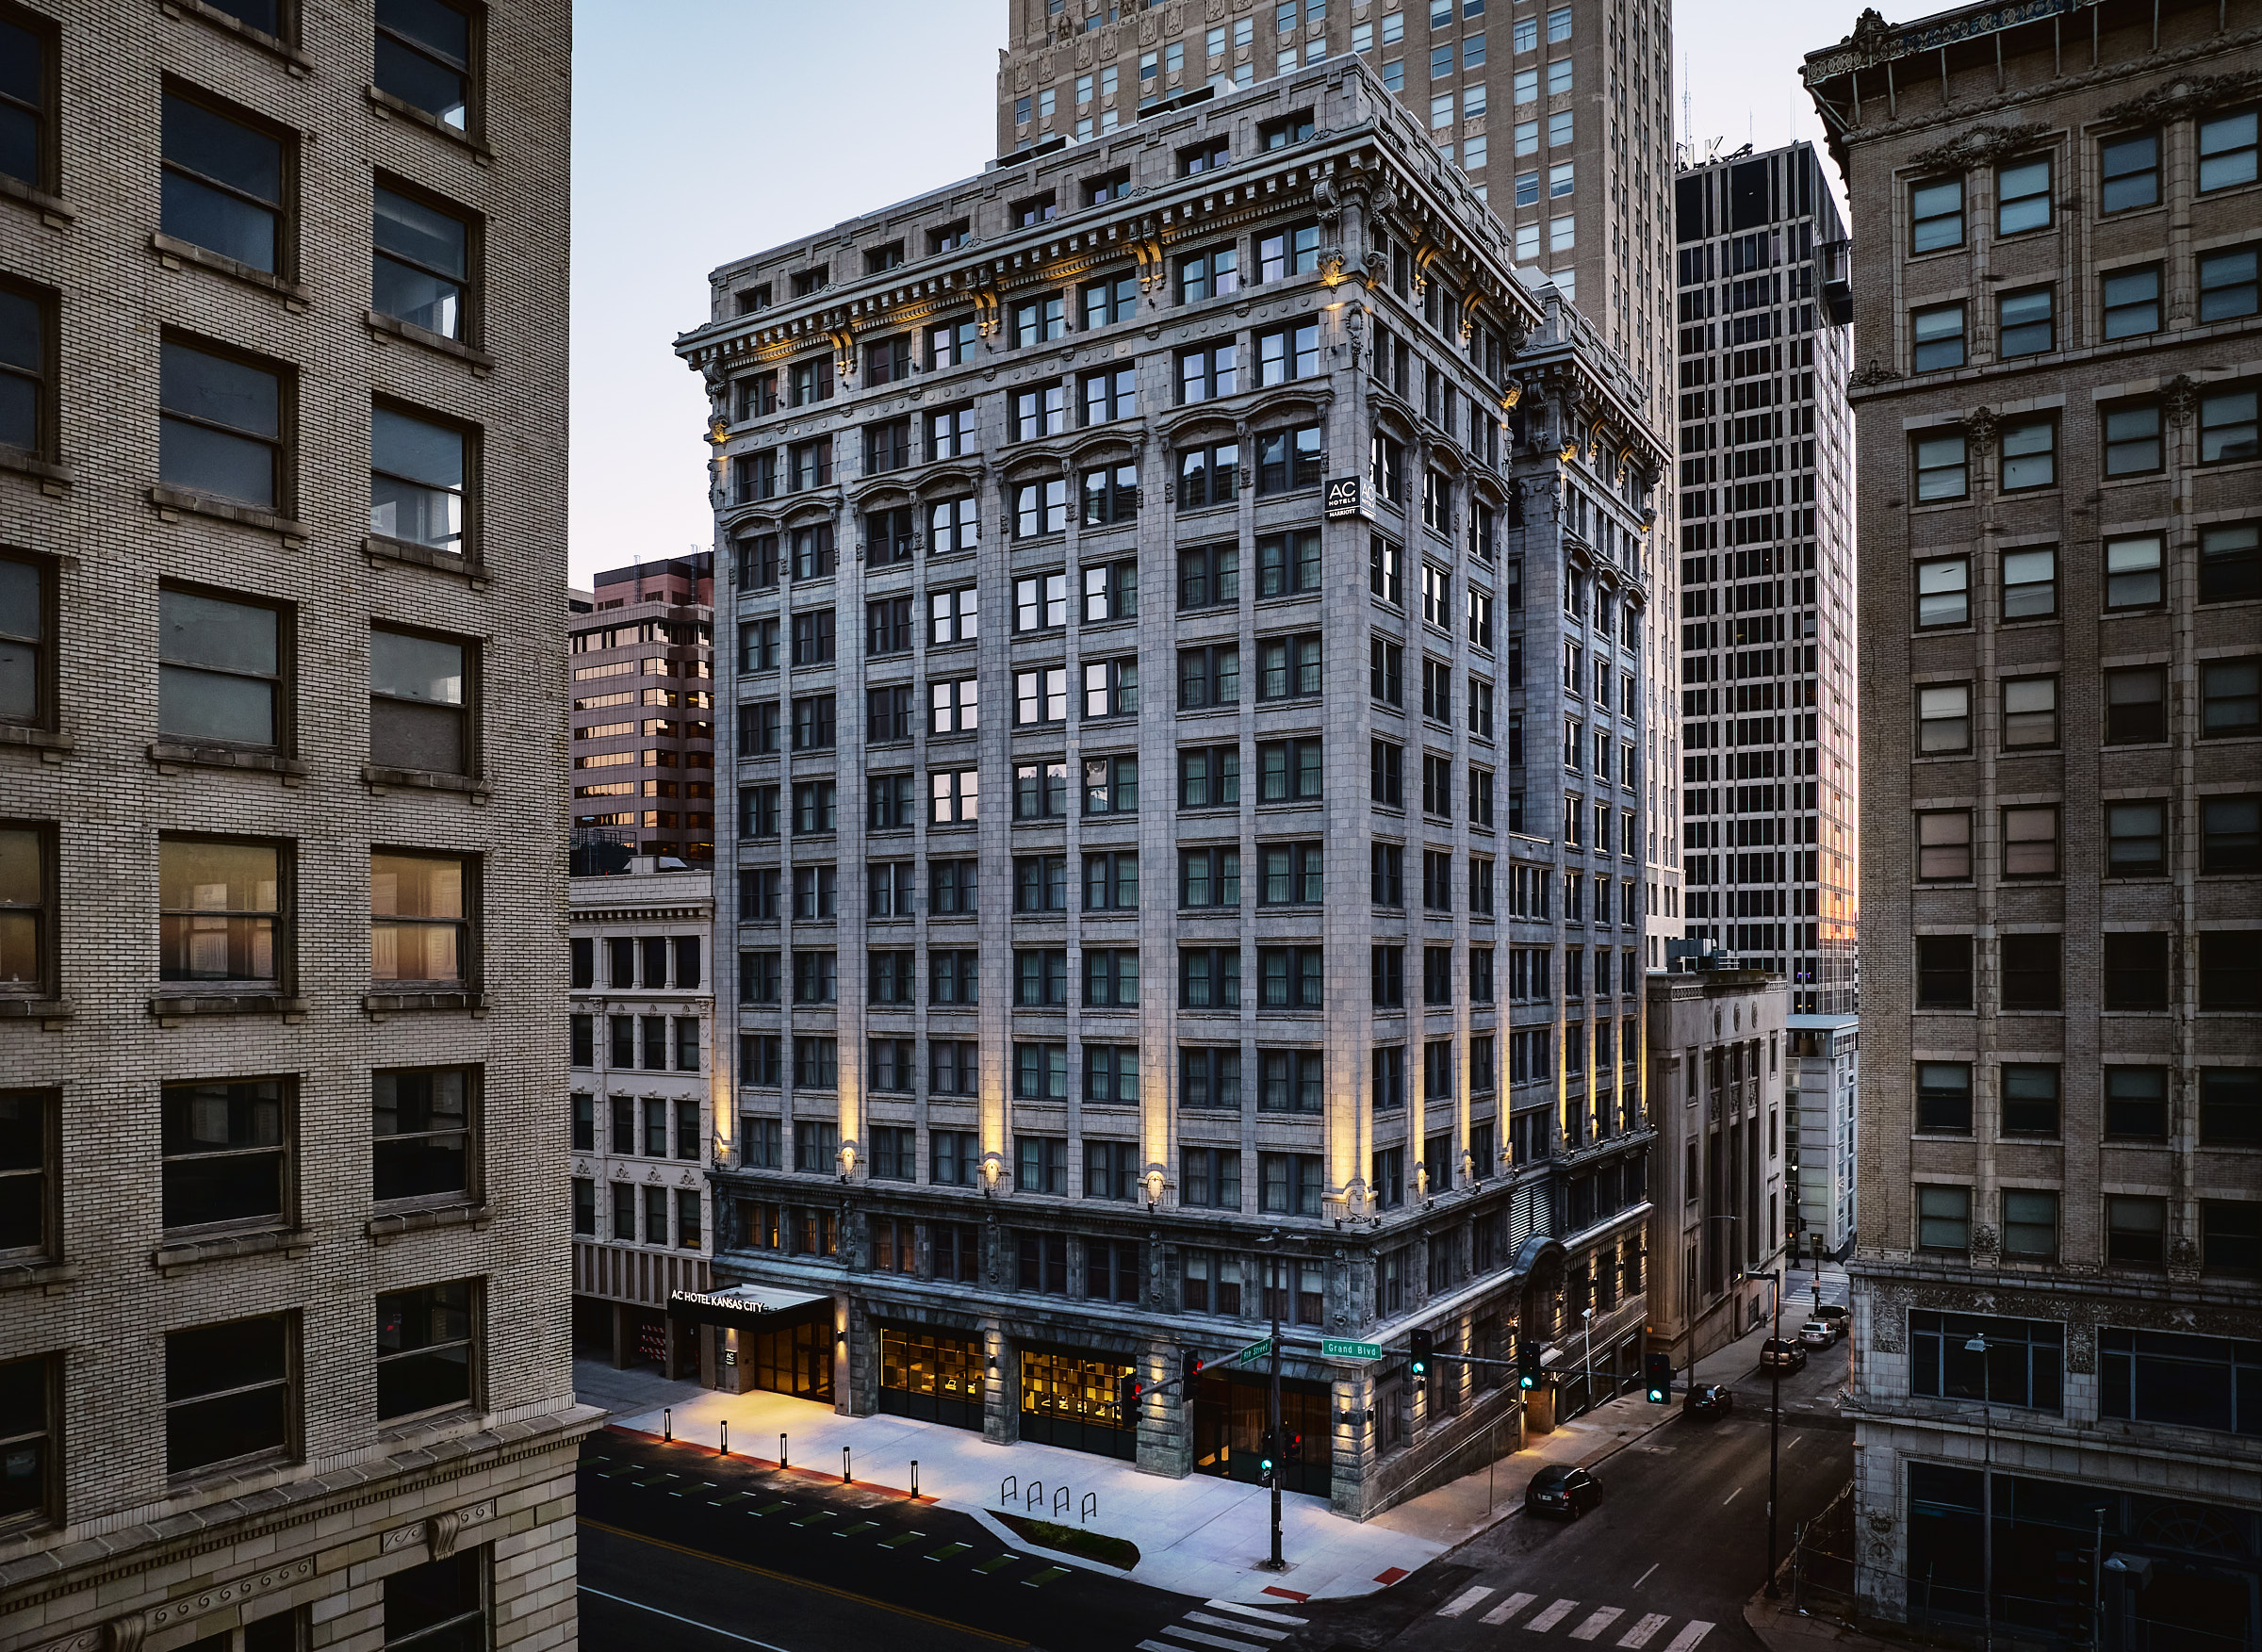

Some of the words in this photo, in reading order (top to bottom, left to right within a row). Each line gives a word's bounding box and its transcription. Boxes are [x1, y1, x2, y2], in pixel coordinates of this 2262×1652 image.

[1329, 482, 1356, 499] AC
[1362, 483, 1374, 501] AC
[1329, 498, 1356, 506] HOTELS
[671, 1289, 683, 1300] AC
[684, 1292, 711, 1305] HOTEL
[712, 1296, 743, 1310] KANSAS
[744, 1300, 764, 1313] CITY
[1328, 1343, 1352, 1353] Grand
[1357, 1346, 1376, 1356] Blvd
